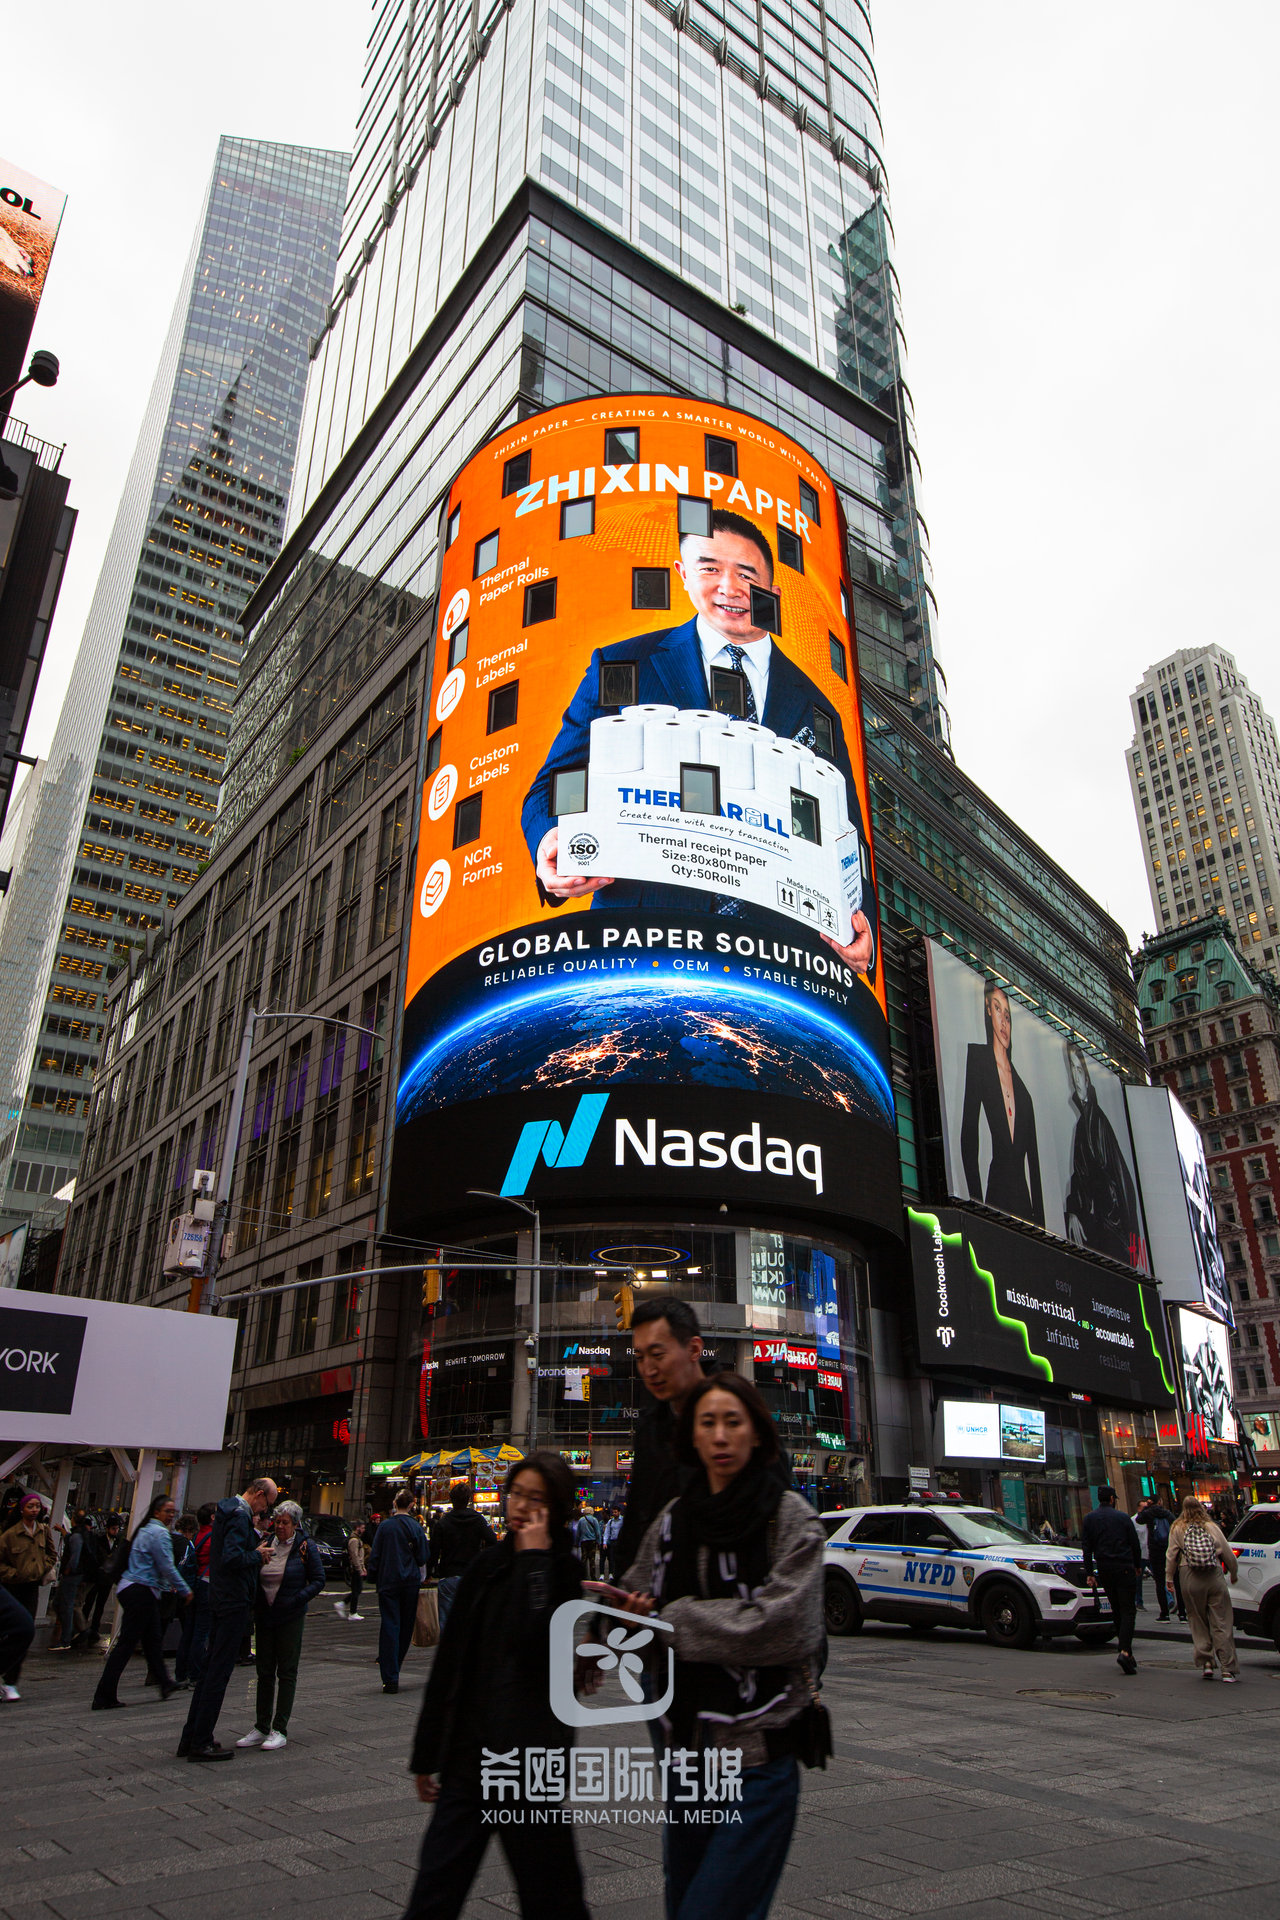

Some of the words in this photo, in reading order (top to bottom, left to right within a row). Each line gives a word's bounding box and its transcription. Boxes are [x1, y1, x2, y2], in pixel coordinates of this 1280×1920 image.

[494, 434, 528, 460] ZHIXIN
[533, 420, 569, 437] PAPER
[591, 409, 655, 421] CREATING
[662, 410, 670, 418] A
[676, 411, 733, 430] SMARTER
[738, 426, 775, 449] WORLD
[780, 447, 802, 467] WITH
[806, 466, 827, 493] PAPER
[515, 463, 689, 518] ZHIXIN
[703, 471, 811, 544] PAPER
[479, 579, 514, 606] Paper
[517, 567, 550, 587] Rolls
[480, 556, 530, 590] Thermal
[476, 638, 528, 672] Thermal
[475, 660, 516, 689] Labels
[469, 742, 519, 771] Custom
[468, 762, 510, 789] Labels
[619, 809, 652, 821] Create
[656, 814, 680, 824] value
[684, 818, 706, 828] with
[709, 824, 734, 837] every
[738, 829, 790, 854] transaction
[463, 845, 492, 869] NCR
[570, 843, 597, 854] ISO
[638, 832, 687, 848] Thermal
[690, 841, 731, 858] receipt
[734, 850, 767, 868] paper
[462, 861, 503, 887] Forms
[662, 849, 748, 876] Size:80x80mm
[671, 864, 741, 887] Qty:50Rolls
[786, 876, 804, 891] Made
[805, 885, 811, 894] in
[478, 929, 590, 967] GLOBAL
[602, 928, 704, 950] PAPER
[715, 932, 853, 988] SOLUTIONS
[484, 963, 555, 987] RELIABLE
[562, 958, 638, 973] QUALITY
[672, 959, 709, 972] OEM
[743, 966, 797, 988] STABLE
[803, 980, 848, 1006] SUPPLY
[614, 1118, 824, 1195] Nasdaq
[932, 1224, 943, 1252] Labs
[934, 1253, 949, 1317] Cockroach
[1055, 1279, 1072, 1297] easy
[1006, 1288, 1076, 1322] mission-critical
[1091, 1298, 1131, 1323] inexpensive
[578, 1346, 610, 1356] Nasdaq
[1046, 1327, 1080, 1350] infinite
[1095, 1327, 1135, 1349] accountable
[445, 1356, 468, 1367] REWRITE
[469, 1352, 506, 1363] TOMORROW
[1099, 1354, 1131, 1372] resilient
[984, 1554, 1006, 1563] POLICE
[903, 1560, 956, 1587] NYPD
